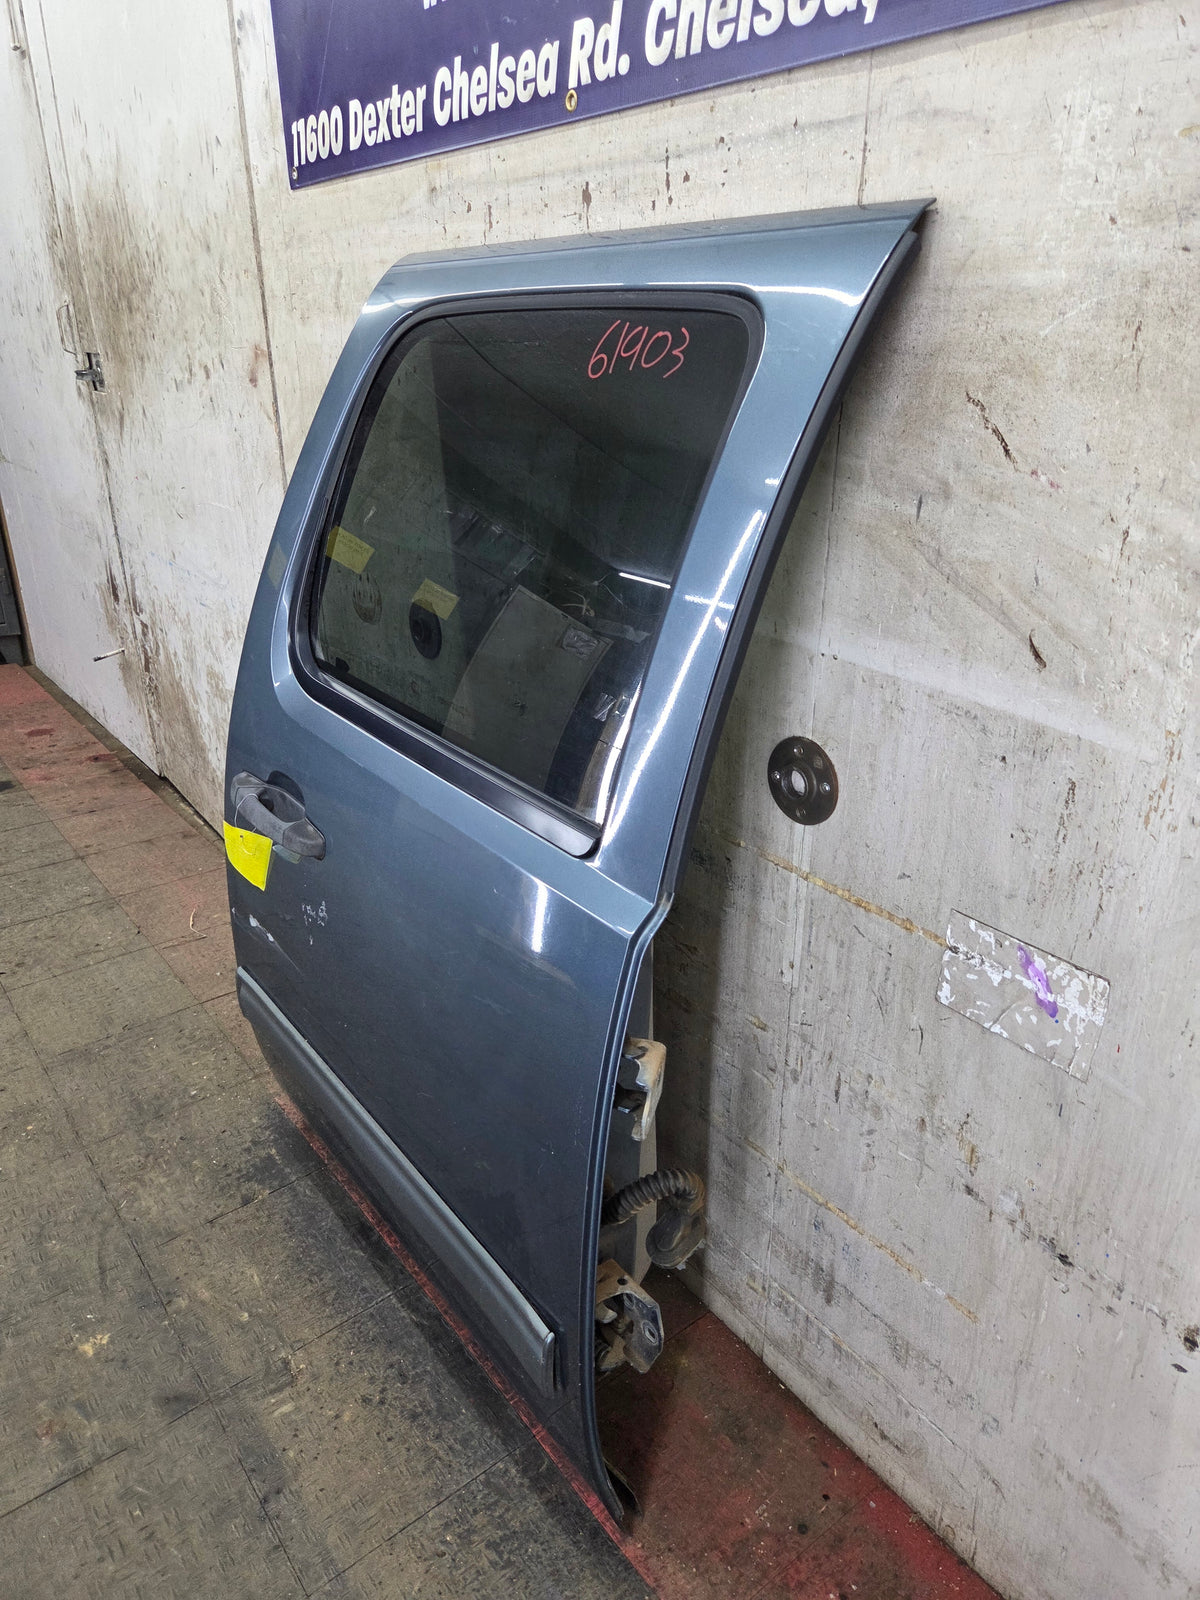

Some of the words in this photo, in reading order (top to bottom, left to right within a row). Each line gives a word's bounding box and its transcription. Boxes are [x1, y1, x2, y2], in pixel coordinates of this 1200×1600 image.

[291, 105, 343, 167] 11600
[349, 83, 427, 151] Dexter
[433, 41, 560, 126] Chelsea
[568, 0, 630, 89] Rd.
[645, 0, 879, 66] Chels,
[588, 320, 689, 379] 61903
